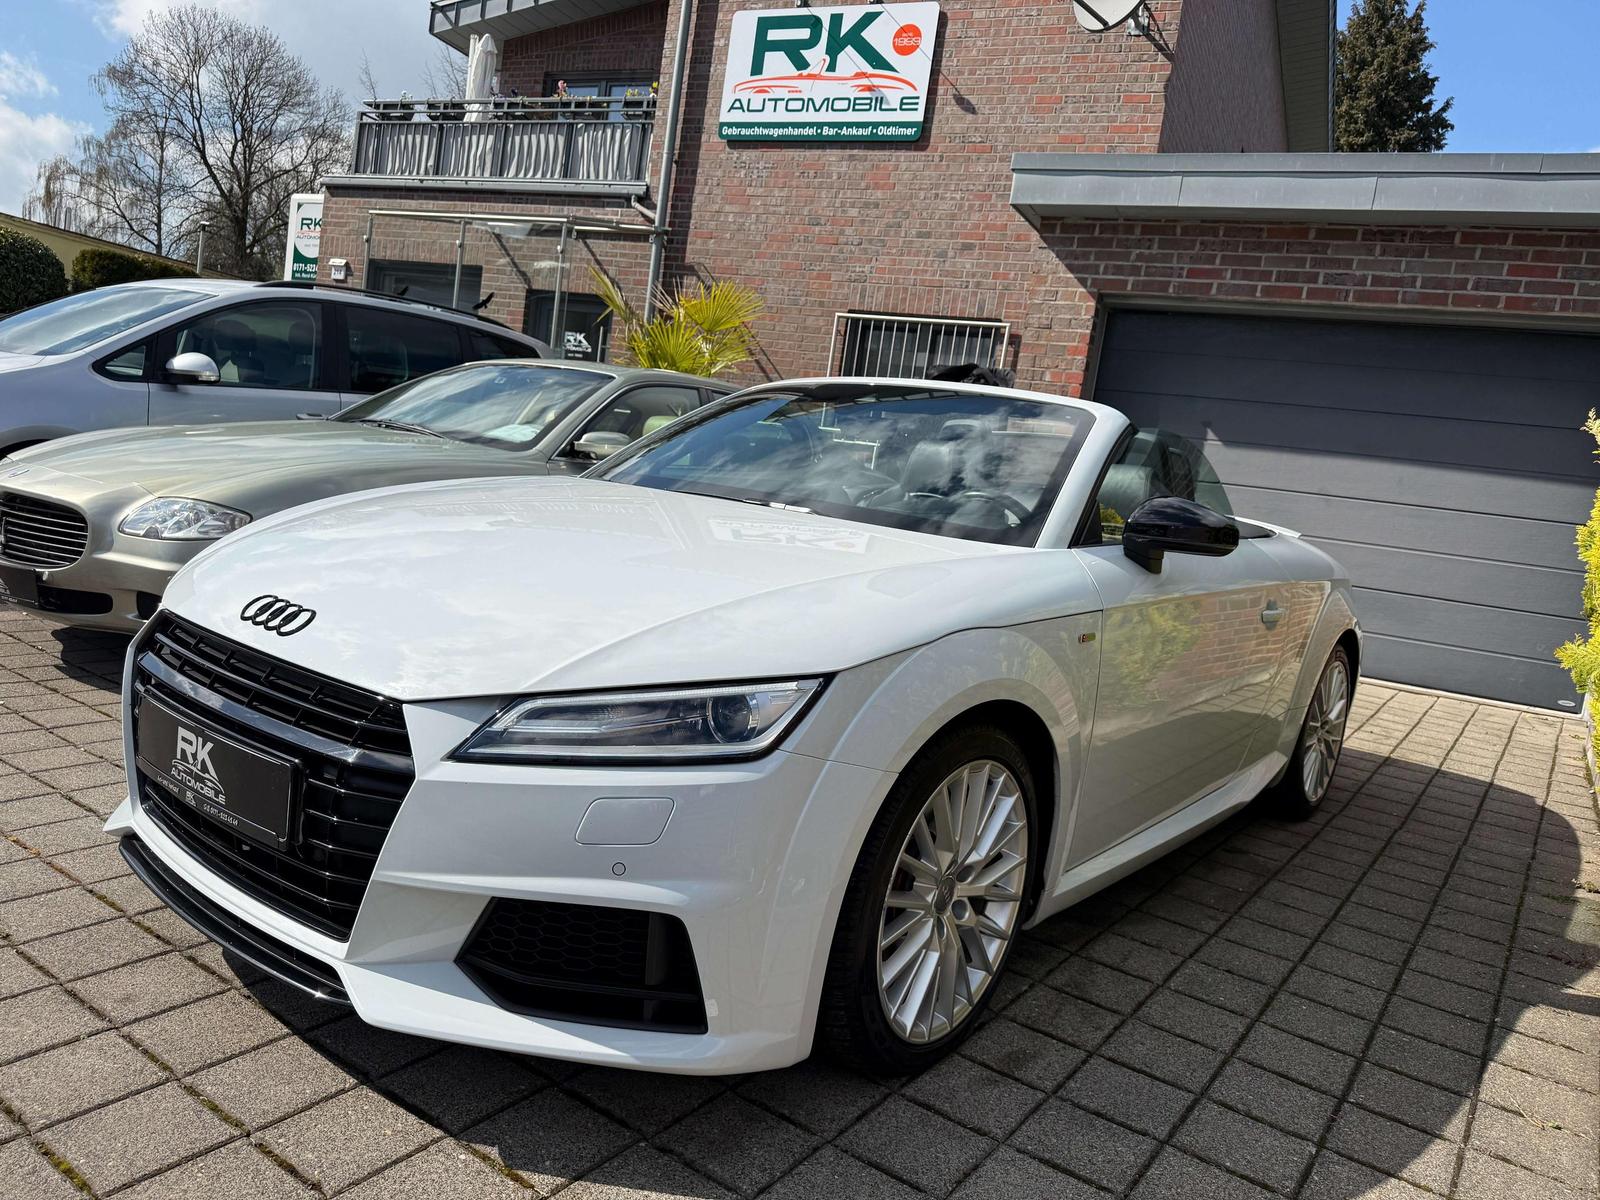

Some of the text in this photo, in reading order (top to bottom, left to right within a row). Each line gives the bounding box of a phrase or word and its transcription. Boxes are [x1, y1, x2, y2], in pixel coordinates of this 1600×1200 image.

[750, 11, 900, 76] RK
[727, 96, 920, 113] AUTOMOBILE
[721, 125, 917, 138] Gebrauchtwagenhandel Bar-Ankauf Oldtimer
[301, 218, 322, 231] RK
[176, 726, 219, 781] RK
[170, 767, 226, 805] AUTOMOBILE
